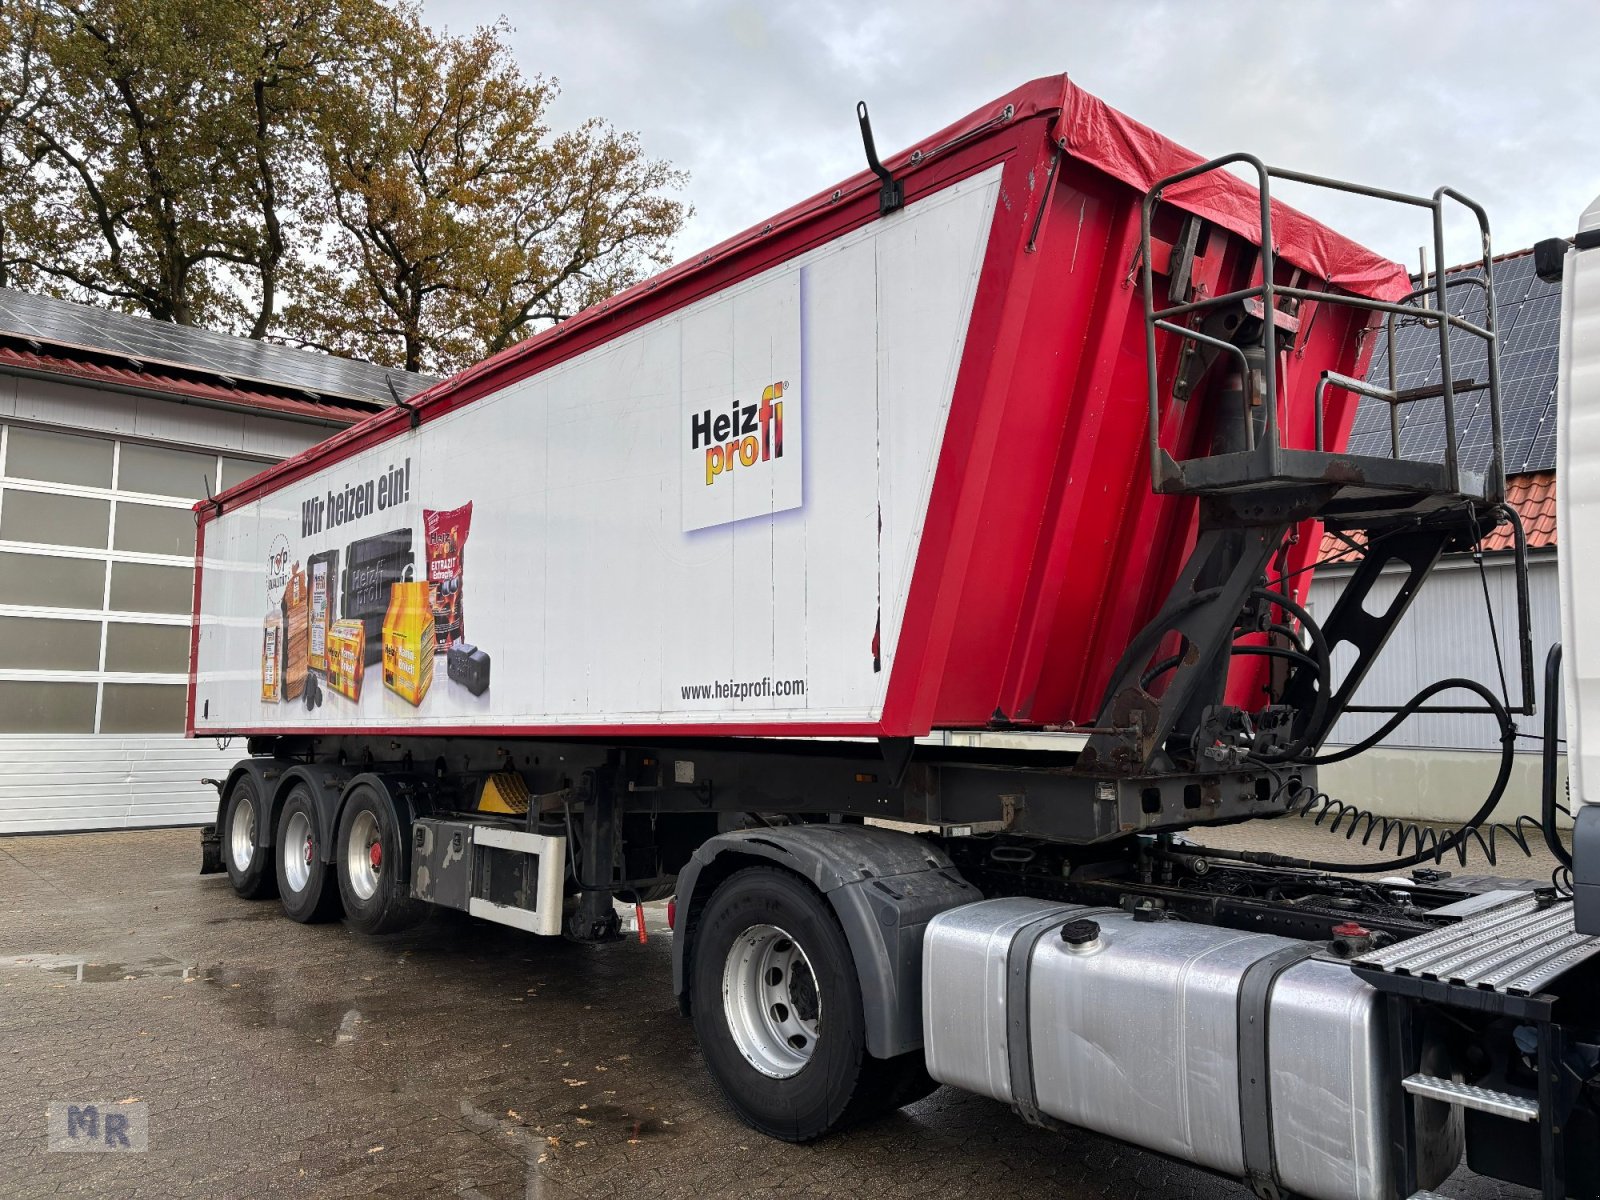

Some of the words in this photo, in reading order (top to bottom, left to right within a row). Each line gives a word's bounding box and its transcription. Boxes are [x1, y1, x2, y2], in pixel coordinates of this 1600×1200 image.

[301, 496, 325, 538] Wir
[326, 479, 375, 530] heizen
[377, 457, 411, 511] ein!
[681, 677, 805, 702] www.heizprofi.com
